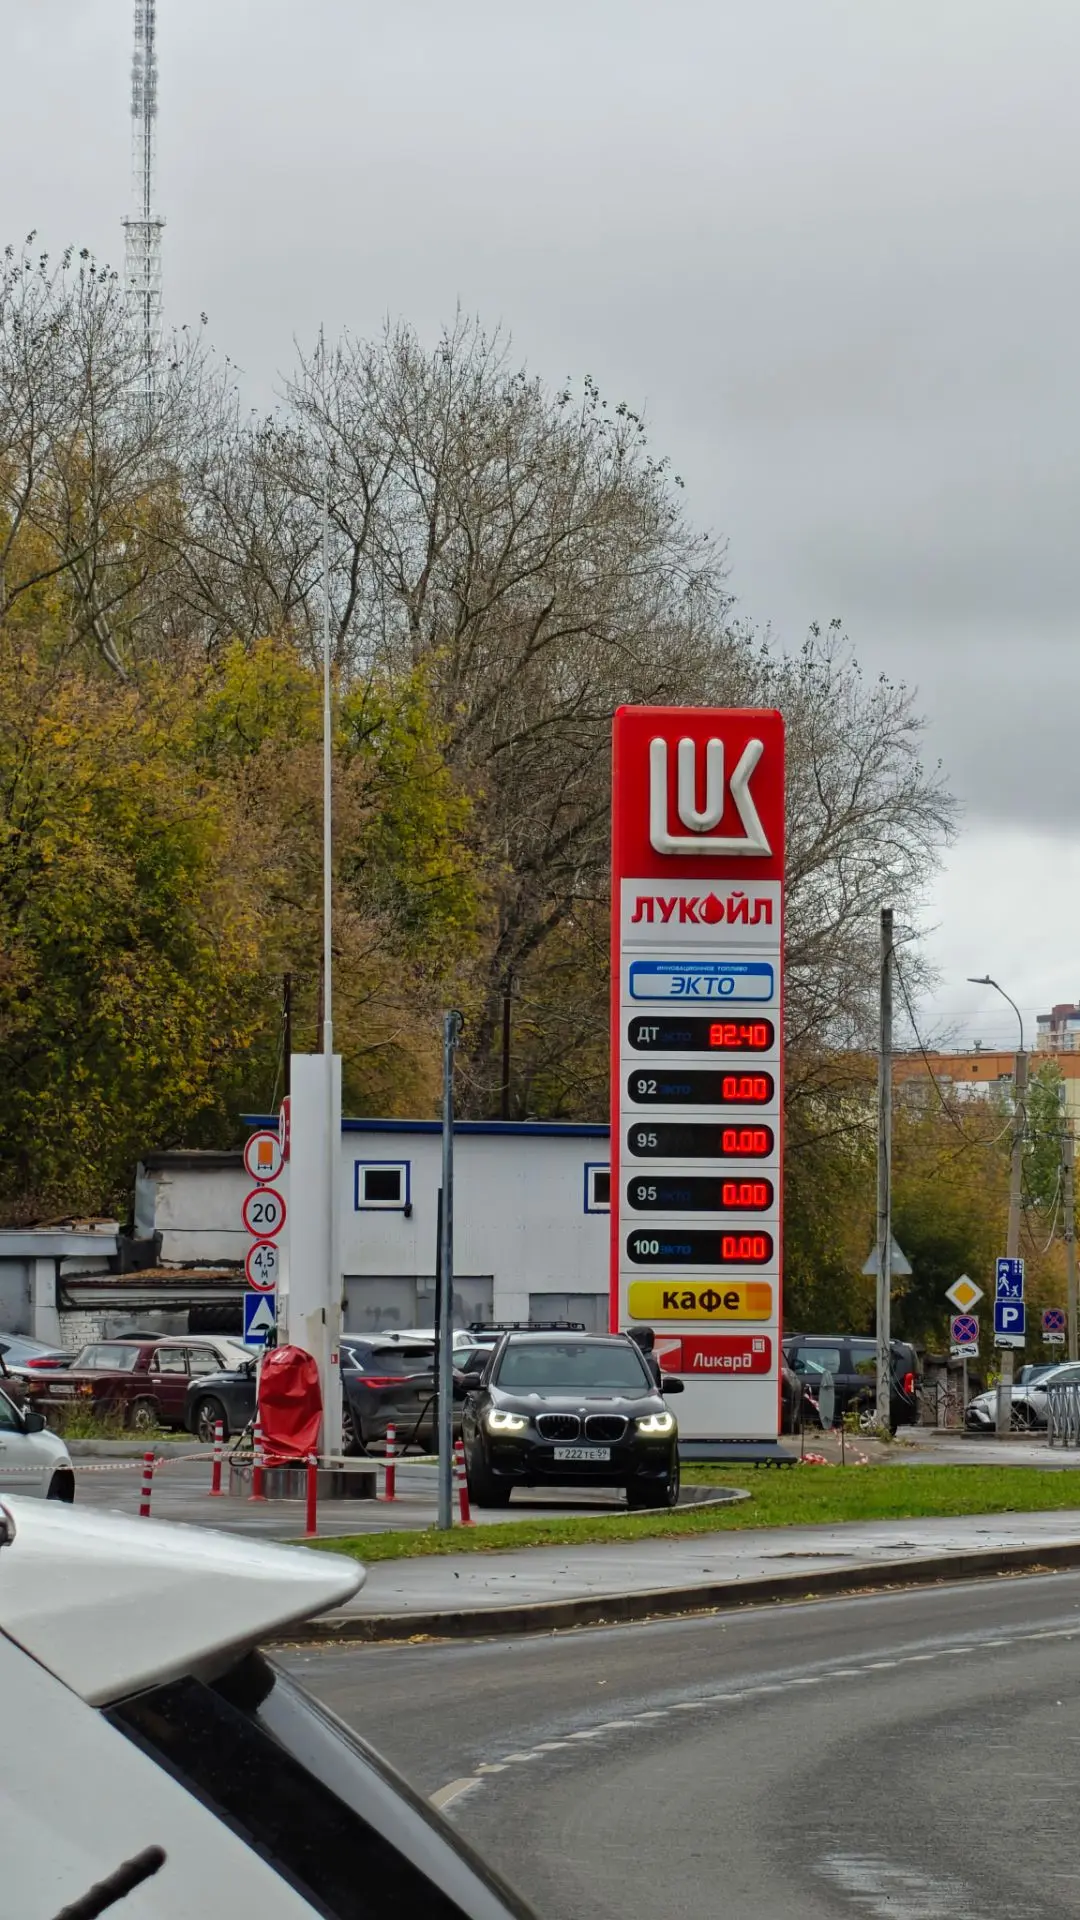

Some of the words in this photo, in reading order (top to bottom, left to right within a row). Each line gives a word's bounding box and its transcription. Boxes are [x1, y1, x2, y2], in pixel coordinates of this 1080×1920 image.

[631, 891, 773, 925] ЛУКОЙЛ
[669, 976, 735, 995] ЭКТО
[636, 1026, 660, 1044] ДТ
[710, 1024, 767, 1046] 82.40
[636, 1079, 657, 1095] 92
[722, 1077, 767, 1099] 0.00
[636, 1132, 658, 1148] 95
[722, 1130, 767, 1152] 0.00
[636, 1186, 658, 1201] 95
[722, 1184, 767, 1206] 0.00
[252, 1203, 276, 1223] 20
[633, 1239, 659, 1255] 100
[722, 1236, 766, 1259] 0.00
[662, 1289, 740, 1312] кафе
[1002, 1307, 1019, 1329] P
[692, 1352, 753, 1371] Ликард
